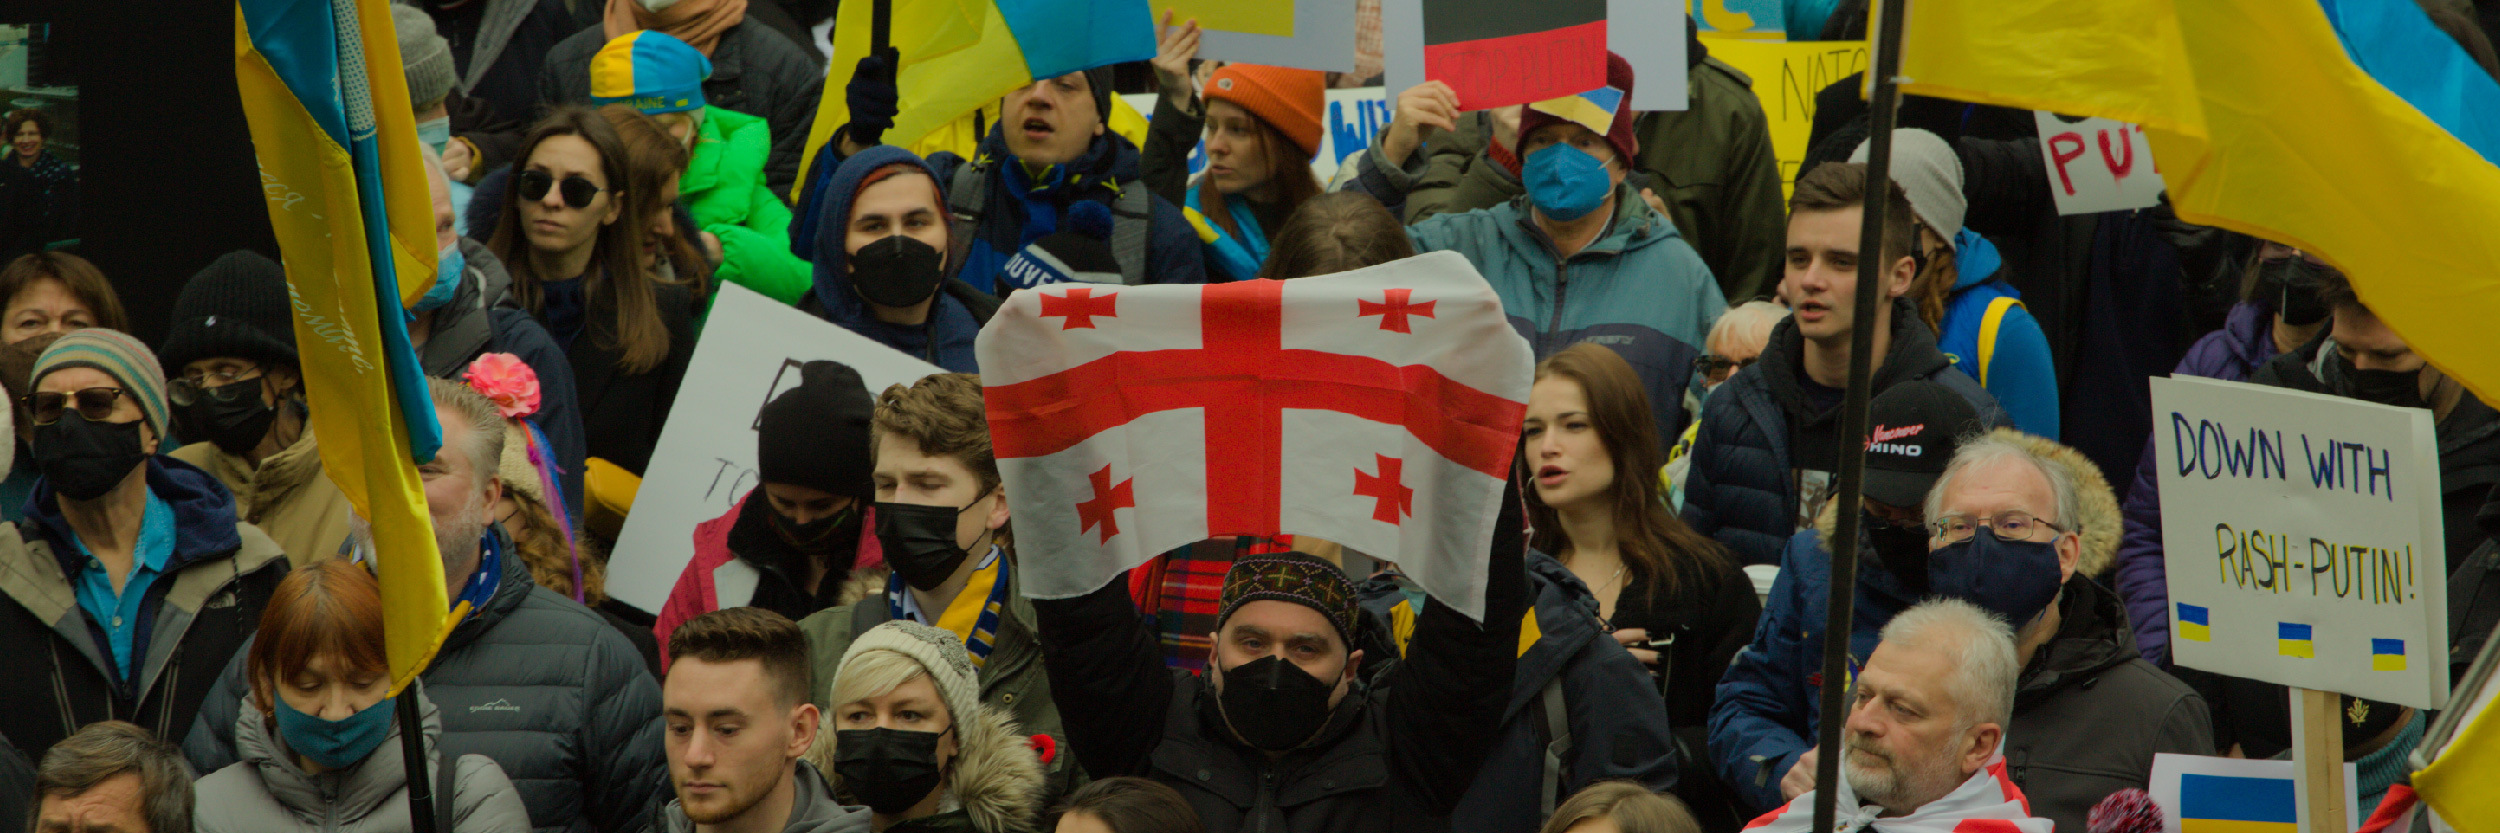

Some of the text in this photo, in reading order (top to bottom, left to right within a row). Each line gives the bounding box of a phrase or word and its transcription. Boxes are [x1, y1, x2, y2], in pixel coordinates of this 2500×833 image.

[1518, 33, 1597, 94] PUTIN
[1868, 442, 1923, 457] HINO
[1873, 423, 1925, 444] Vancouver
[2171, 411, 2393, 502] DOWN WITH
[2216, 523, 2415, 605] RASH-PUTIN!
